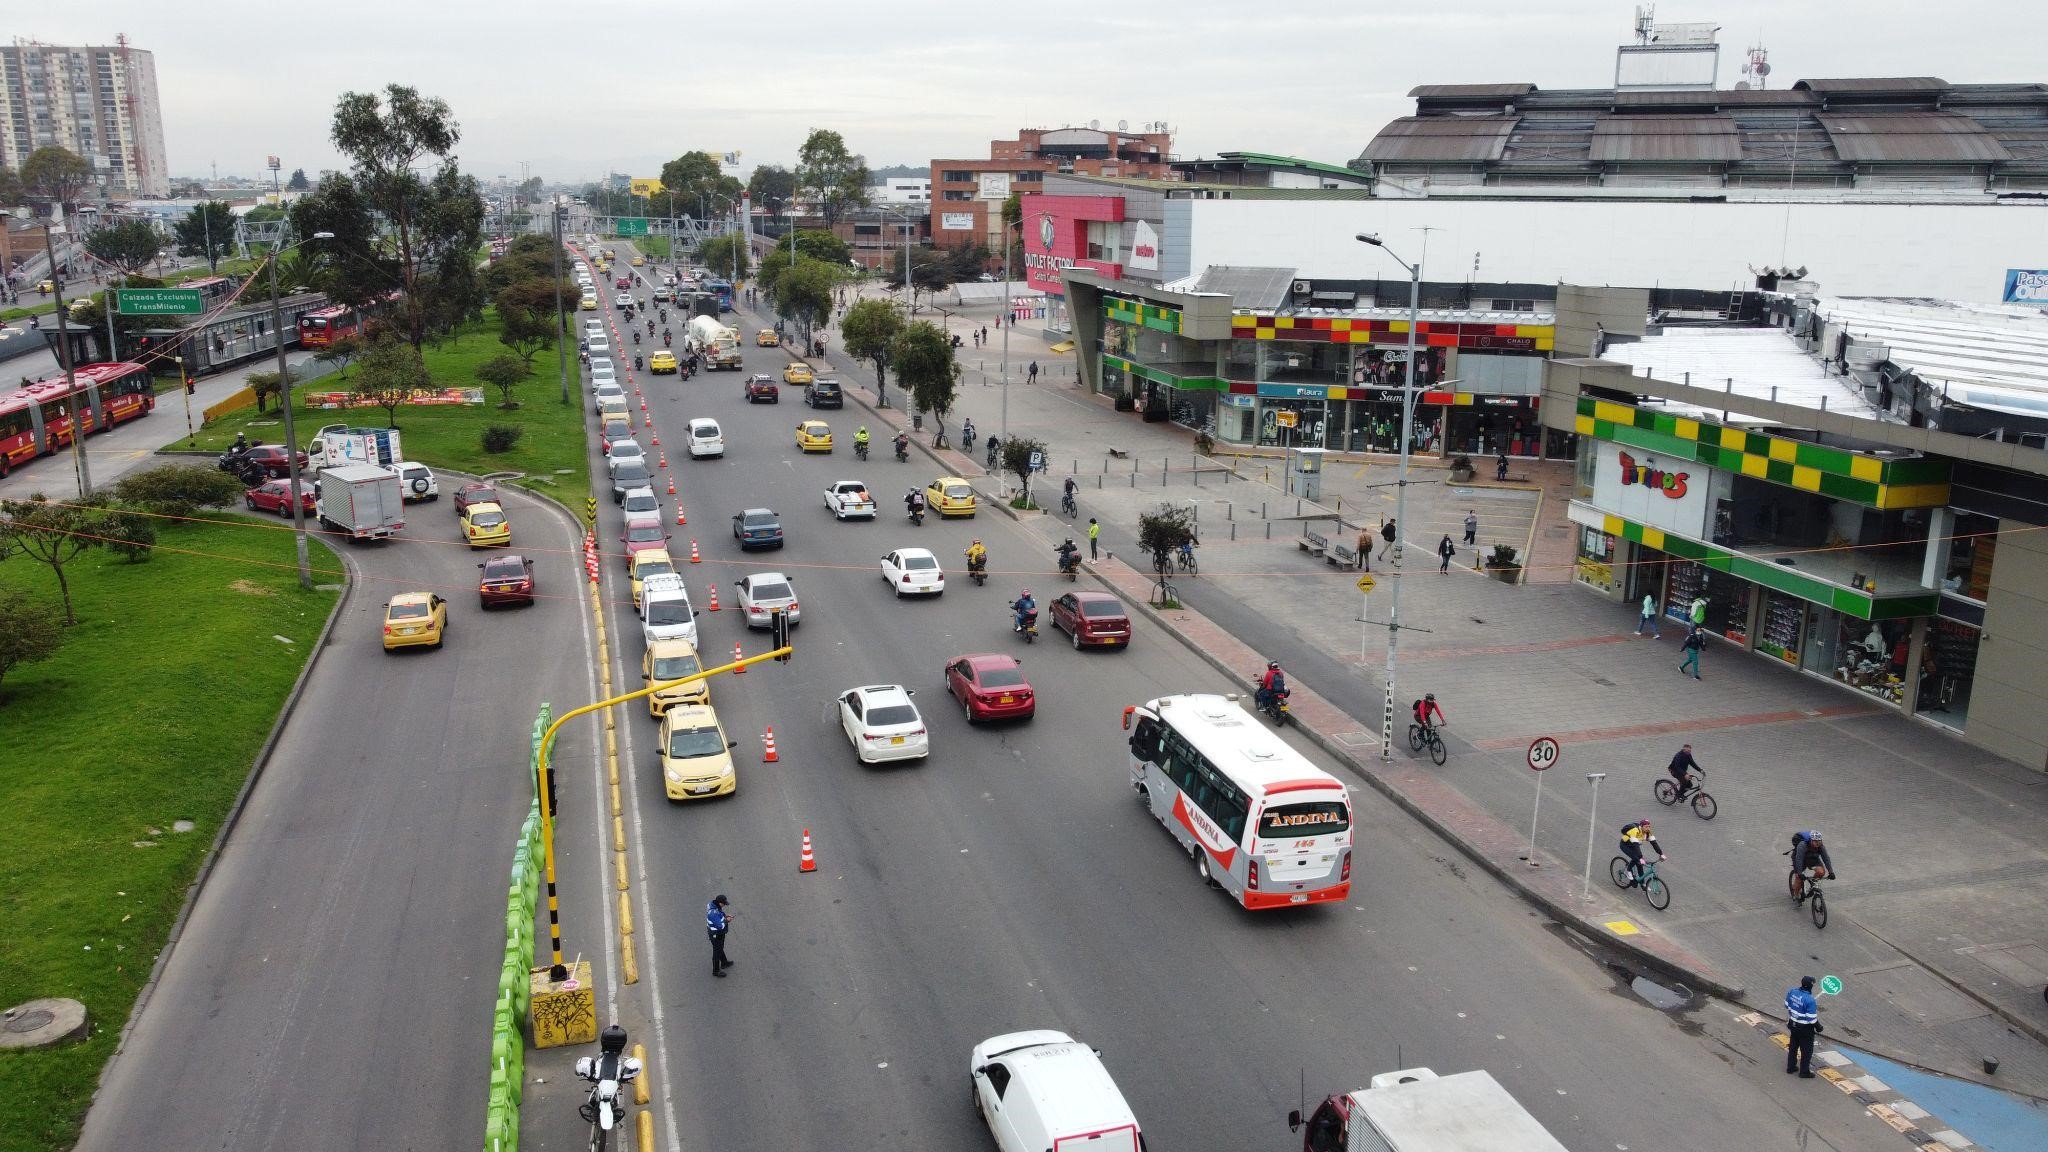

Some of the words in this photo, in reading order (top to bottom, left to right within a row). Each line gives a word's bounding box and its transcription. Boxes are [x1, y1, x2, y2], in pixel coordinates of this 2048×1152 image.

[1025, 252, 1047, 269] OUTLET
[122, 293, 154, 301] Calzada
[157, 293, 196, 301] Exclusiva
[1383, 680, 1394, 757] CUADRANTE
[1532, 746, 1554, 762] 30
[1189, 807, 1219, 845] ANDINA
[1269, 811, 1339, 827] ANDINA
[1823, 977, 1839, 993] SIGA
